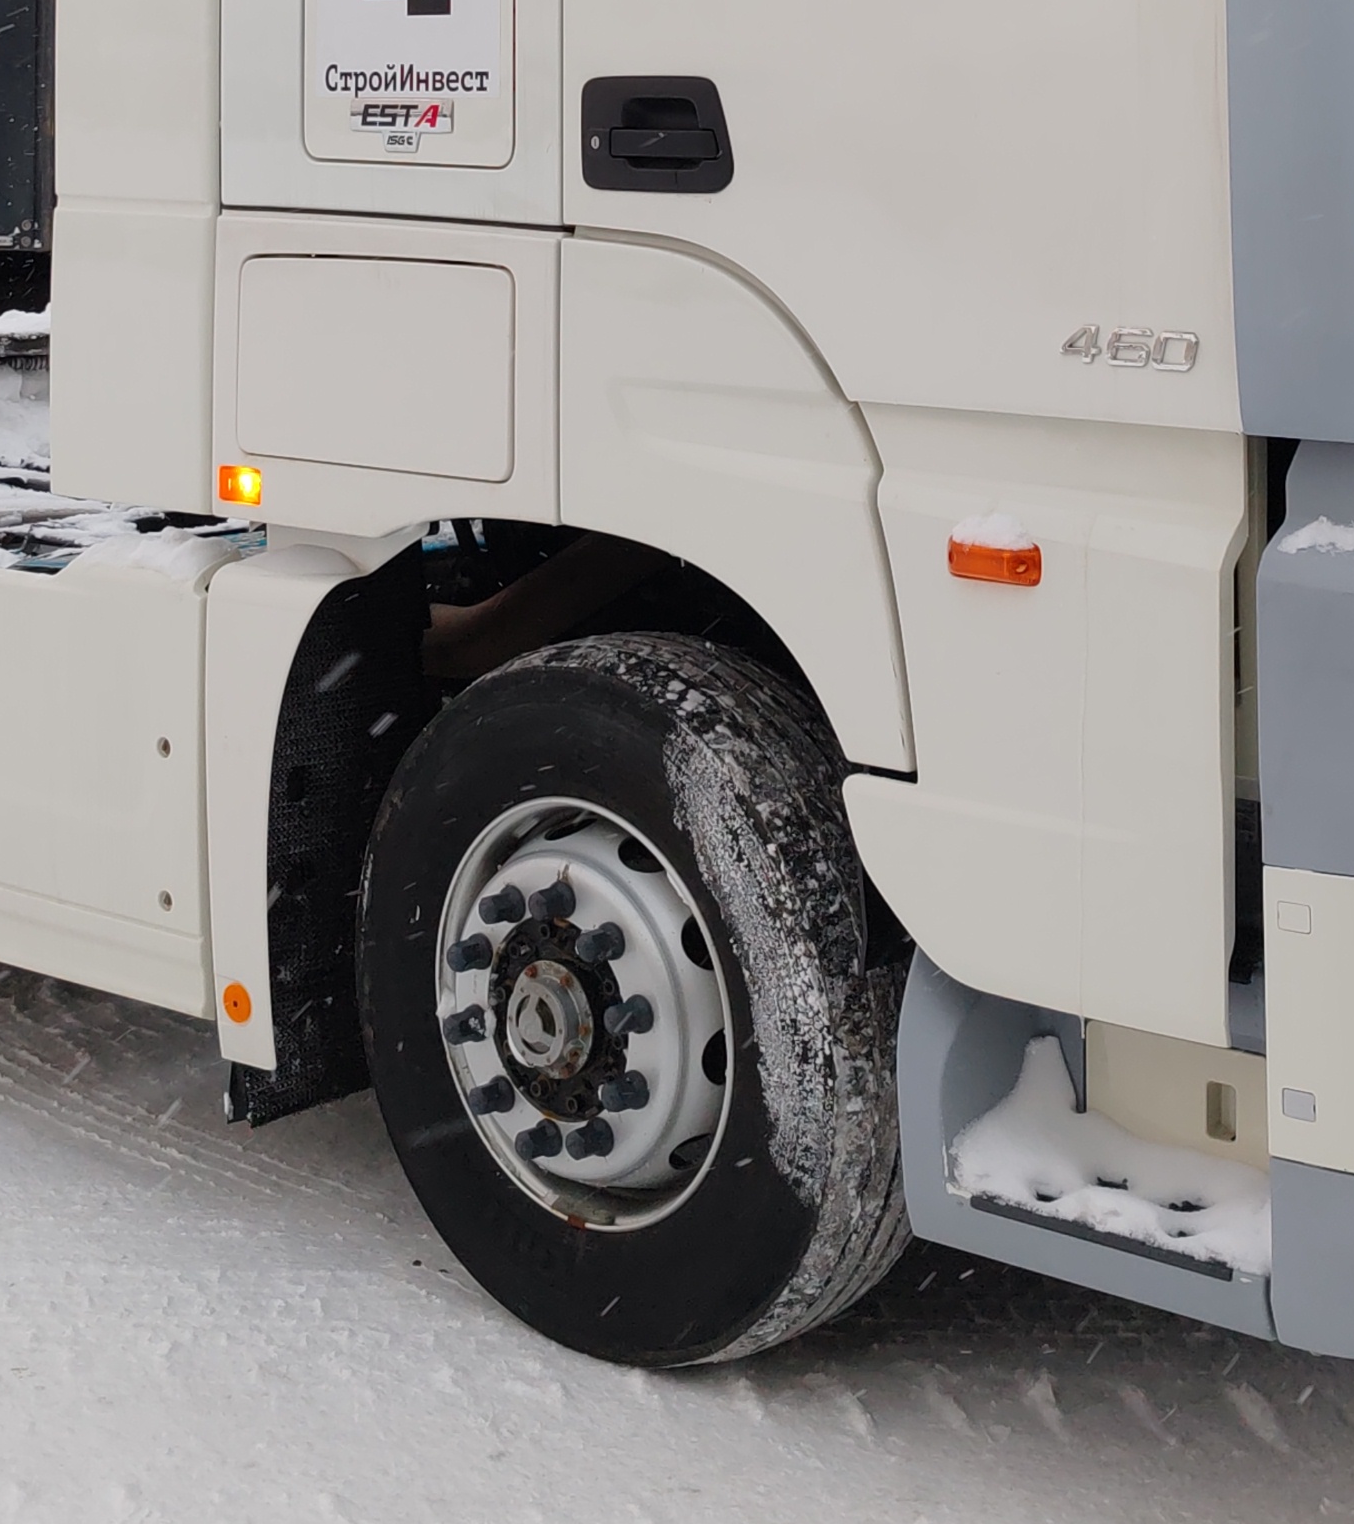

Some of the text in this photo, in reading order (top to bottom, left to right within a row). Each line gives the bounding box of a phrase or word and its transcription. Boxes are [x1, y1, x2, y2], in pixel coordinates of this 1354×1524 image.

[325, 63, 490, 98] СтройИнвест
[361, 103, 440, 128] ESTA
[1059, 324, 1200, 372] 460
